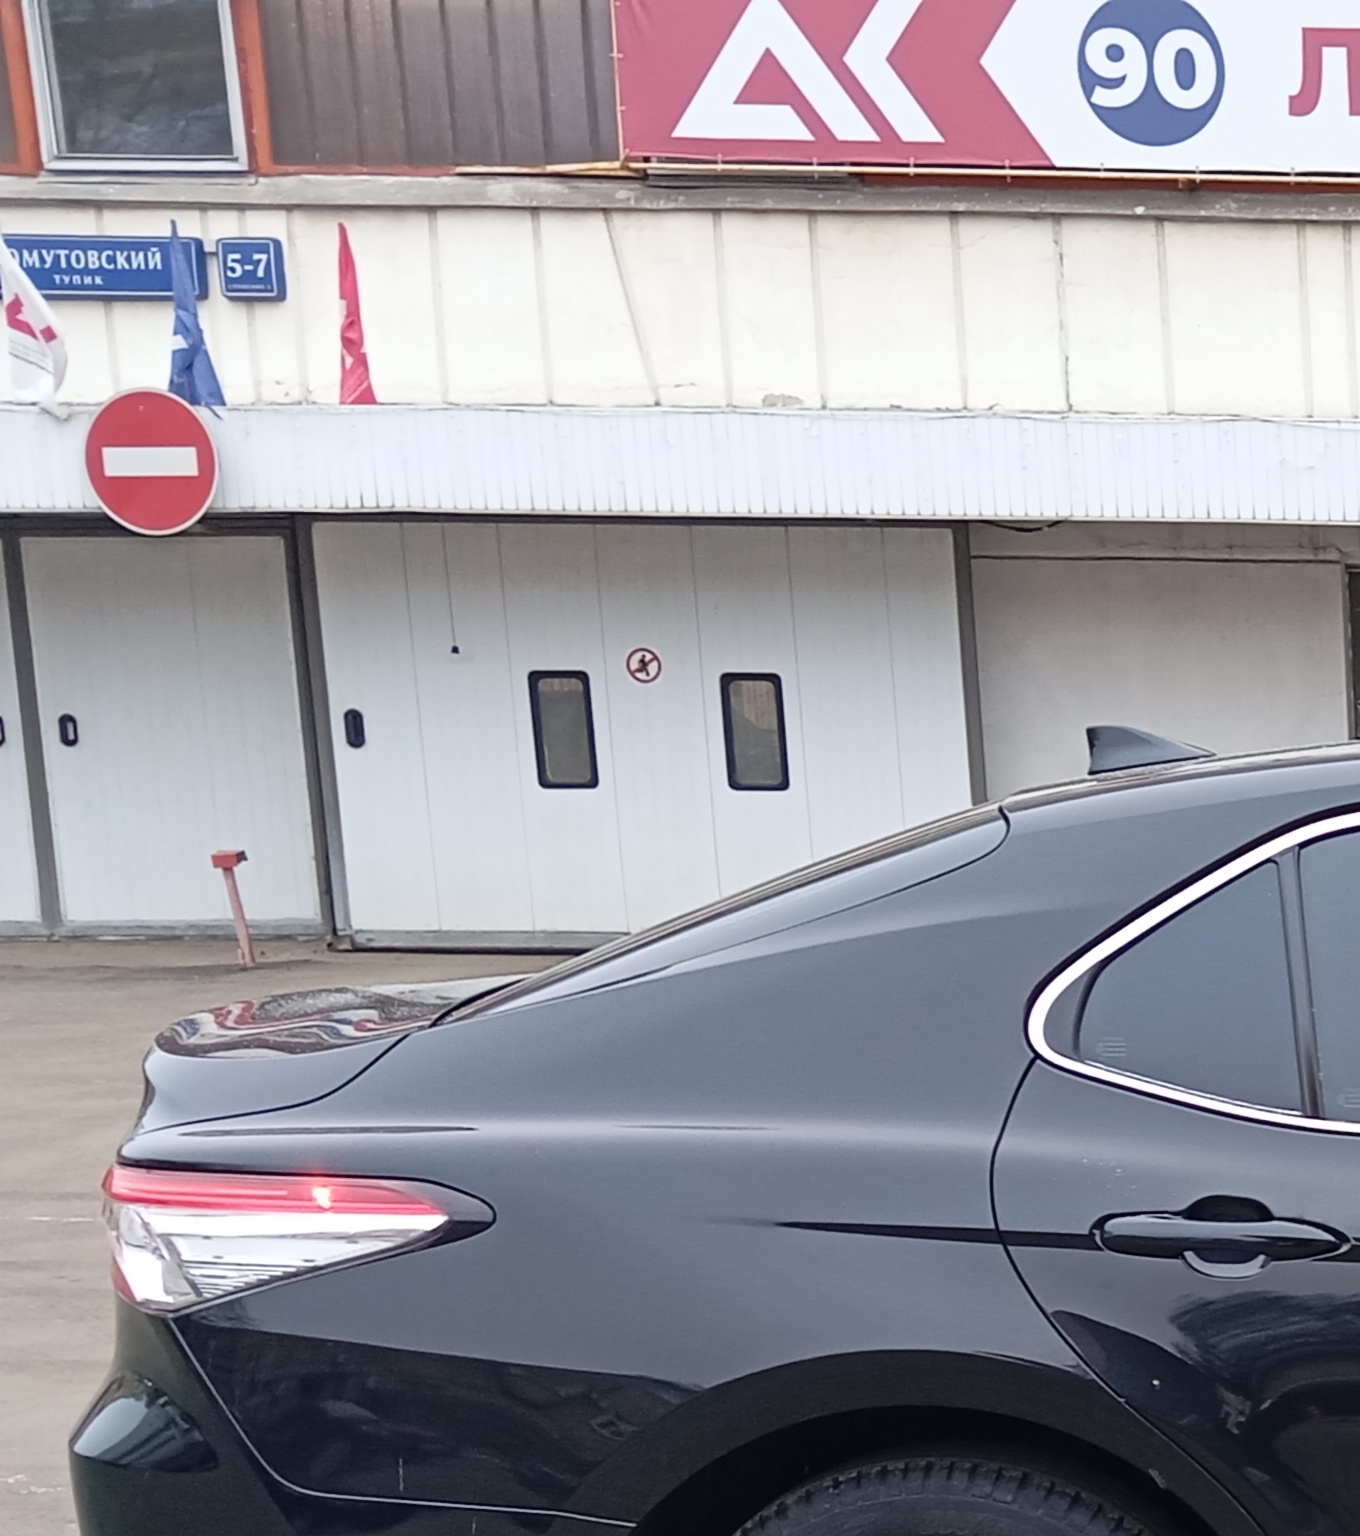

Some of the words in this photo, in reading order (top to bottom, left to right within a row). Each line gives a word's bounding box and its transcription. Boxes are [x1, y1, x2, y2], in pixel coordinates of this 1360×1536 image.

[1084, 26, 1218, 110] 90
[226, 253, 269, 278] 5-7
[53, 274, 104, 286] ТУПИК
